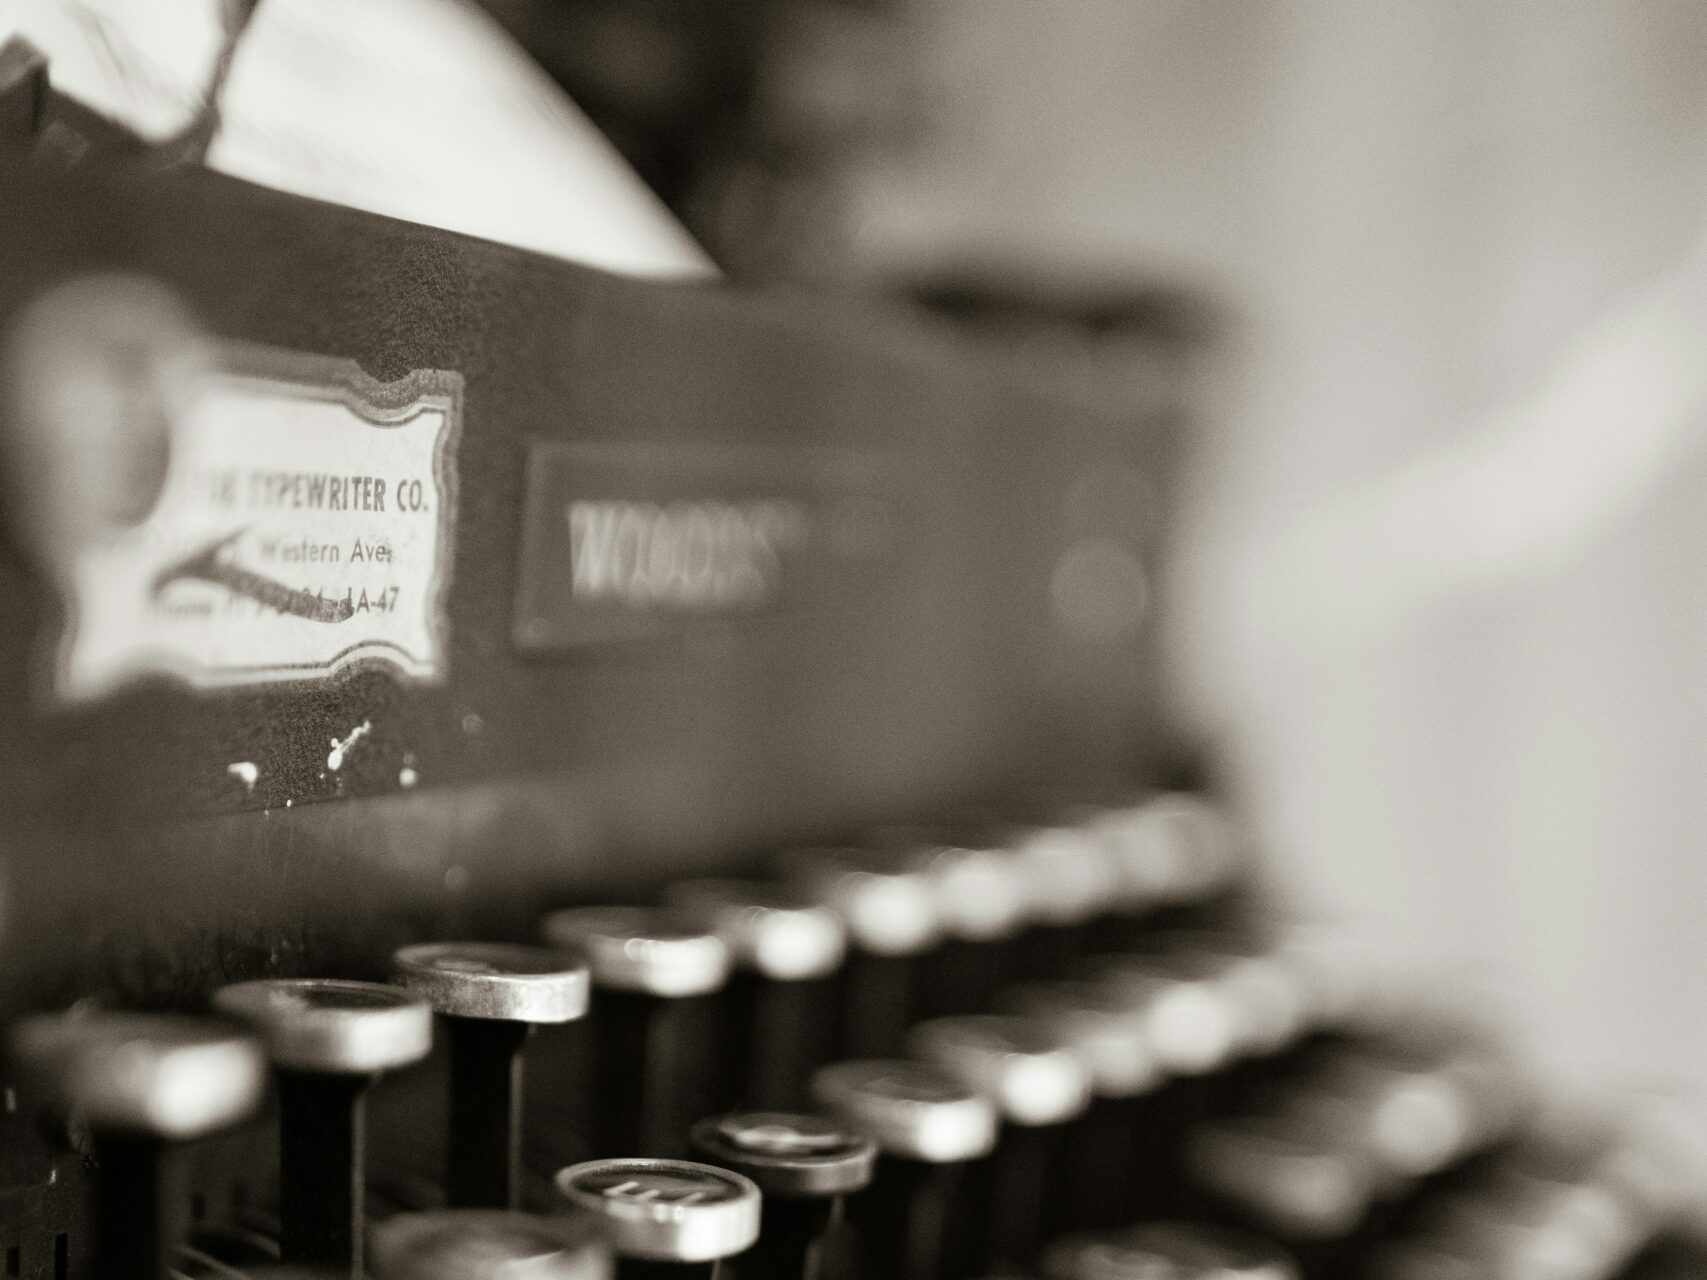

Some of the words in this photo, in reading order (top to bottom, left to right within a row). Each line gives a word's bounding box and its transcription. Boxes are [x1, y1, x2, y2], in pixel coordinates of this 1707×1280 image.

[248, 472, 387, 512] TYPEWRITER
[396, 478, 429, 513] CO.
[261, 537, 340, 563] Western
